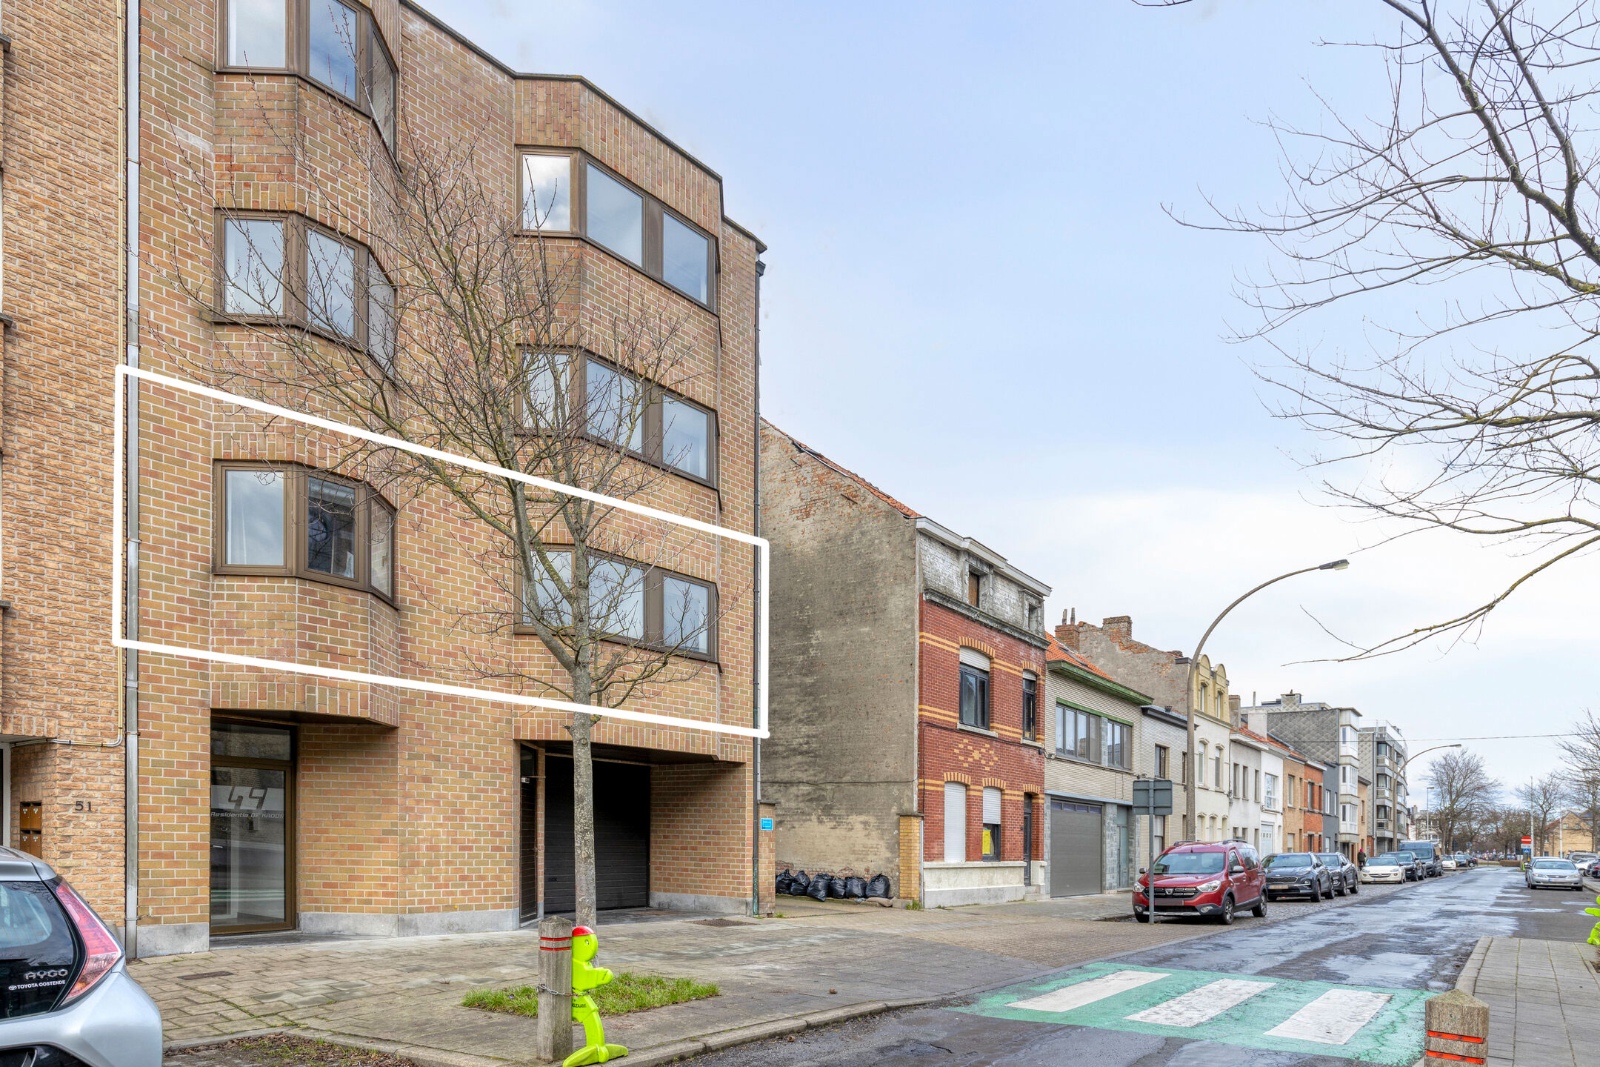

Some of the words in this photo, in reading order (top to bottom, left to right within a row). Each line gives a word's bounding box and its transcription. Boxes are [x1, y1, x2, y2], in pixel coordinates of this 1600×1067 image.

[228, 785, 268, 811] 49
[74, 800, 92, 813] 51
[25, 969, 68, 980] AYGO
